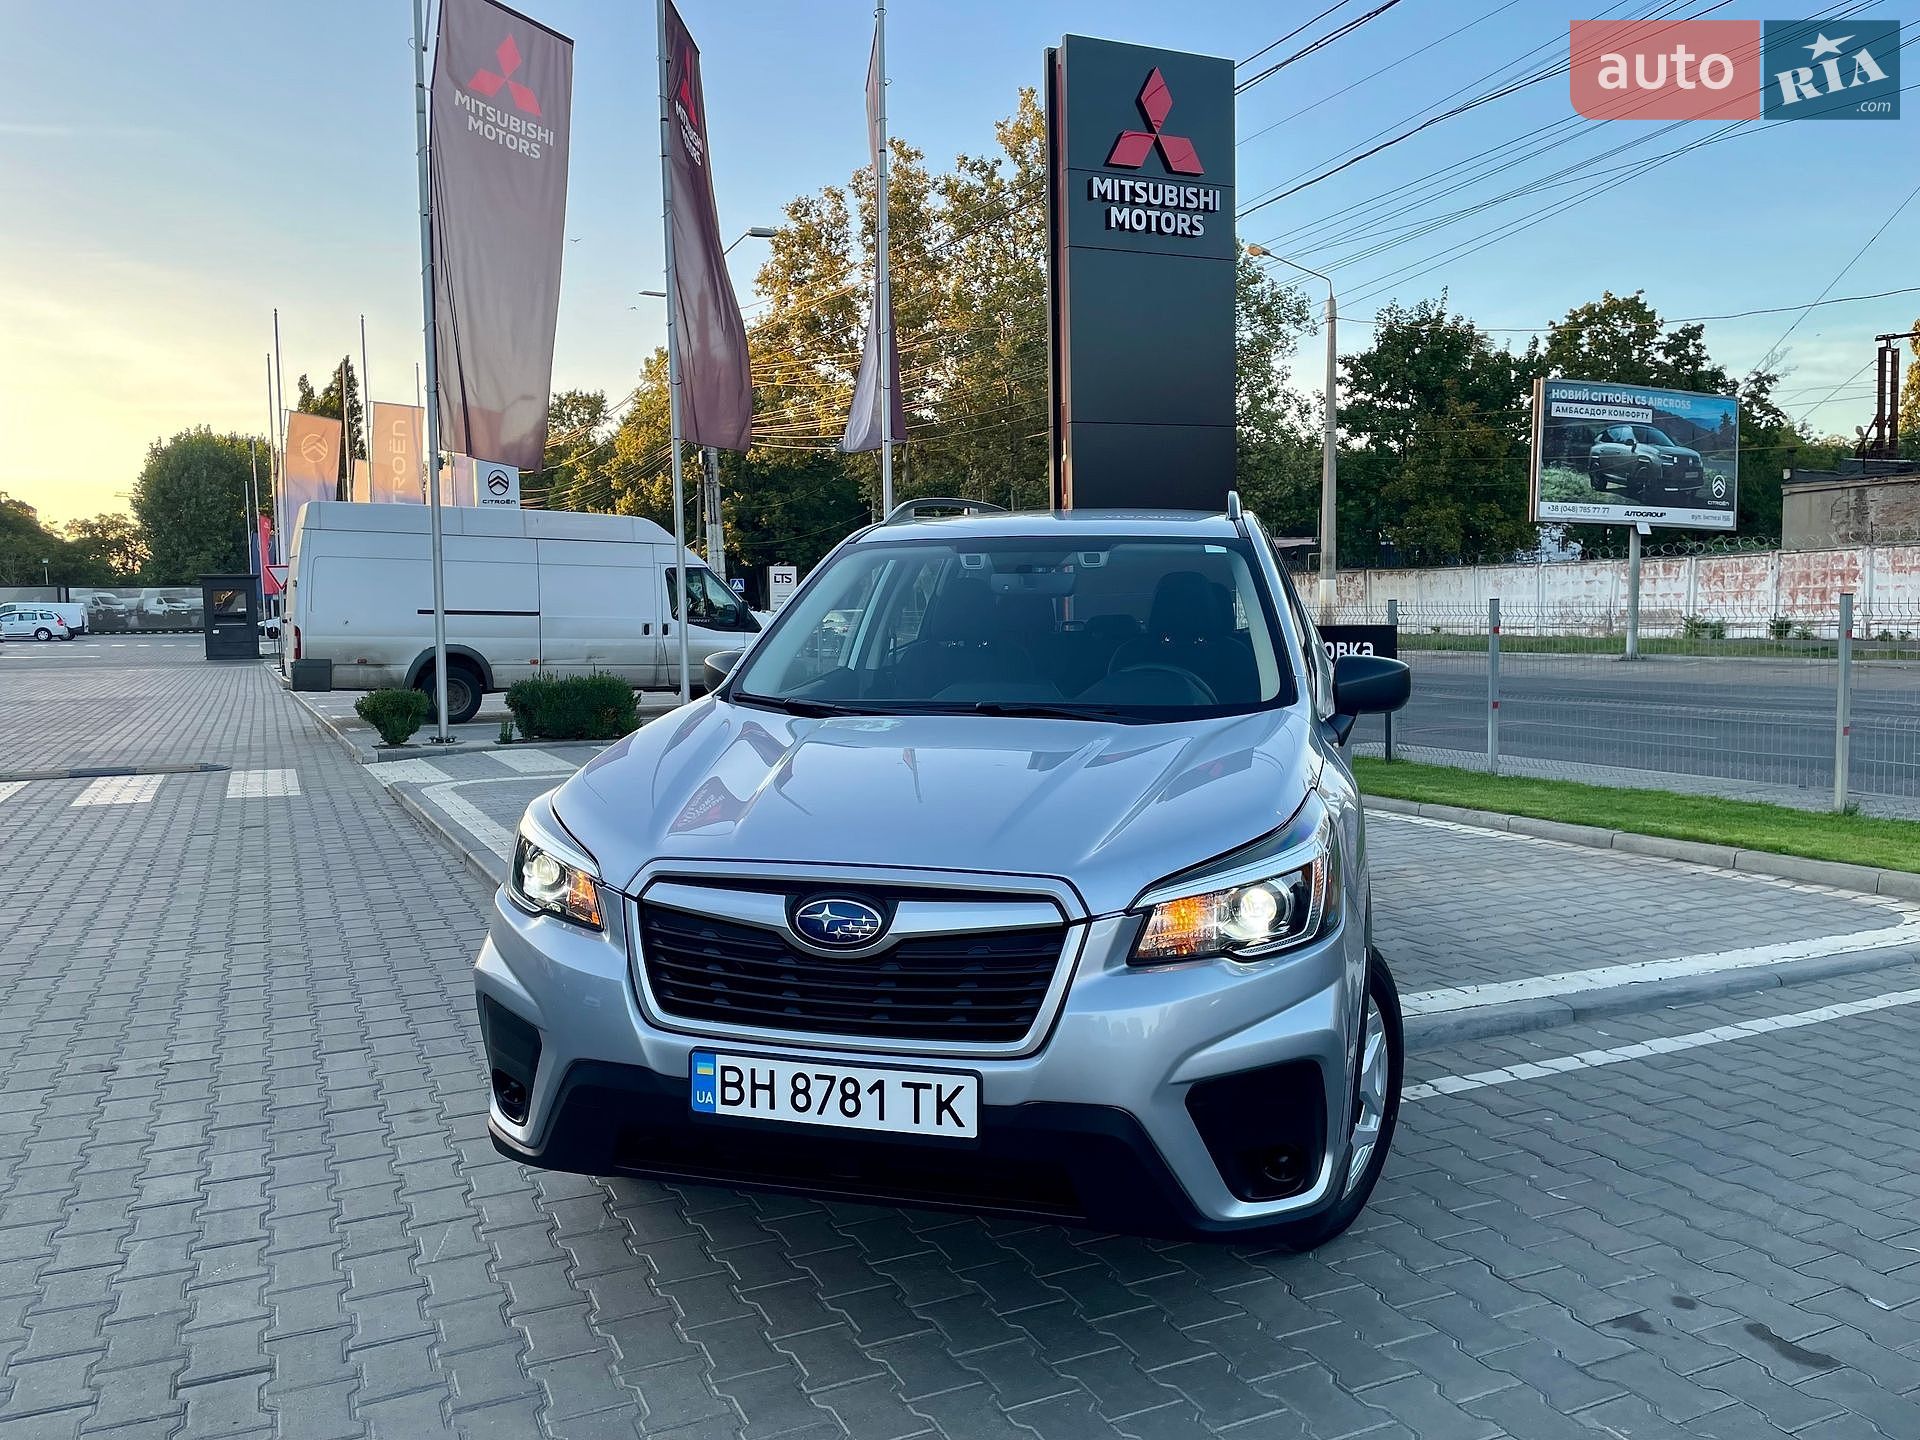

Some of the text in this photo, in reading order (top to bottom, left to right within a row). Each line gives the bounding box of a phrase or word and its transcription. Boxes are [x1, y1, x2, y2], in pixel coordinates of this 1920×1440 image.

[454, 89, 554, 147] MITSUBISHI
[467, 115, 541, 159] MOTORS
[1091, 176, 1221, 211] MITSUBISHI
[1109, 206, 1205, 237] MOTORS
[1551, 388, 1589, 401] НОВИЙ
[1591, 391, 1634, 405] CITROËN
[1648, 397, 1692, 410] AIRCROSS
[1555, 405, 1651, 420] АМБАСАДОР КОМФОРТУ
[696, 1091, 714, 1105] UA
[720, 1064, 966, 1128] BH 8781 TK
